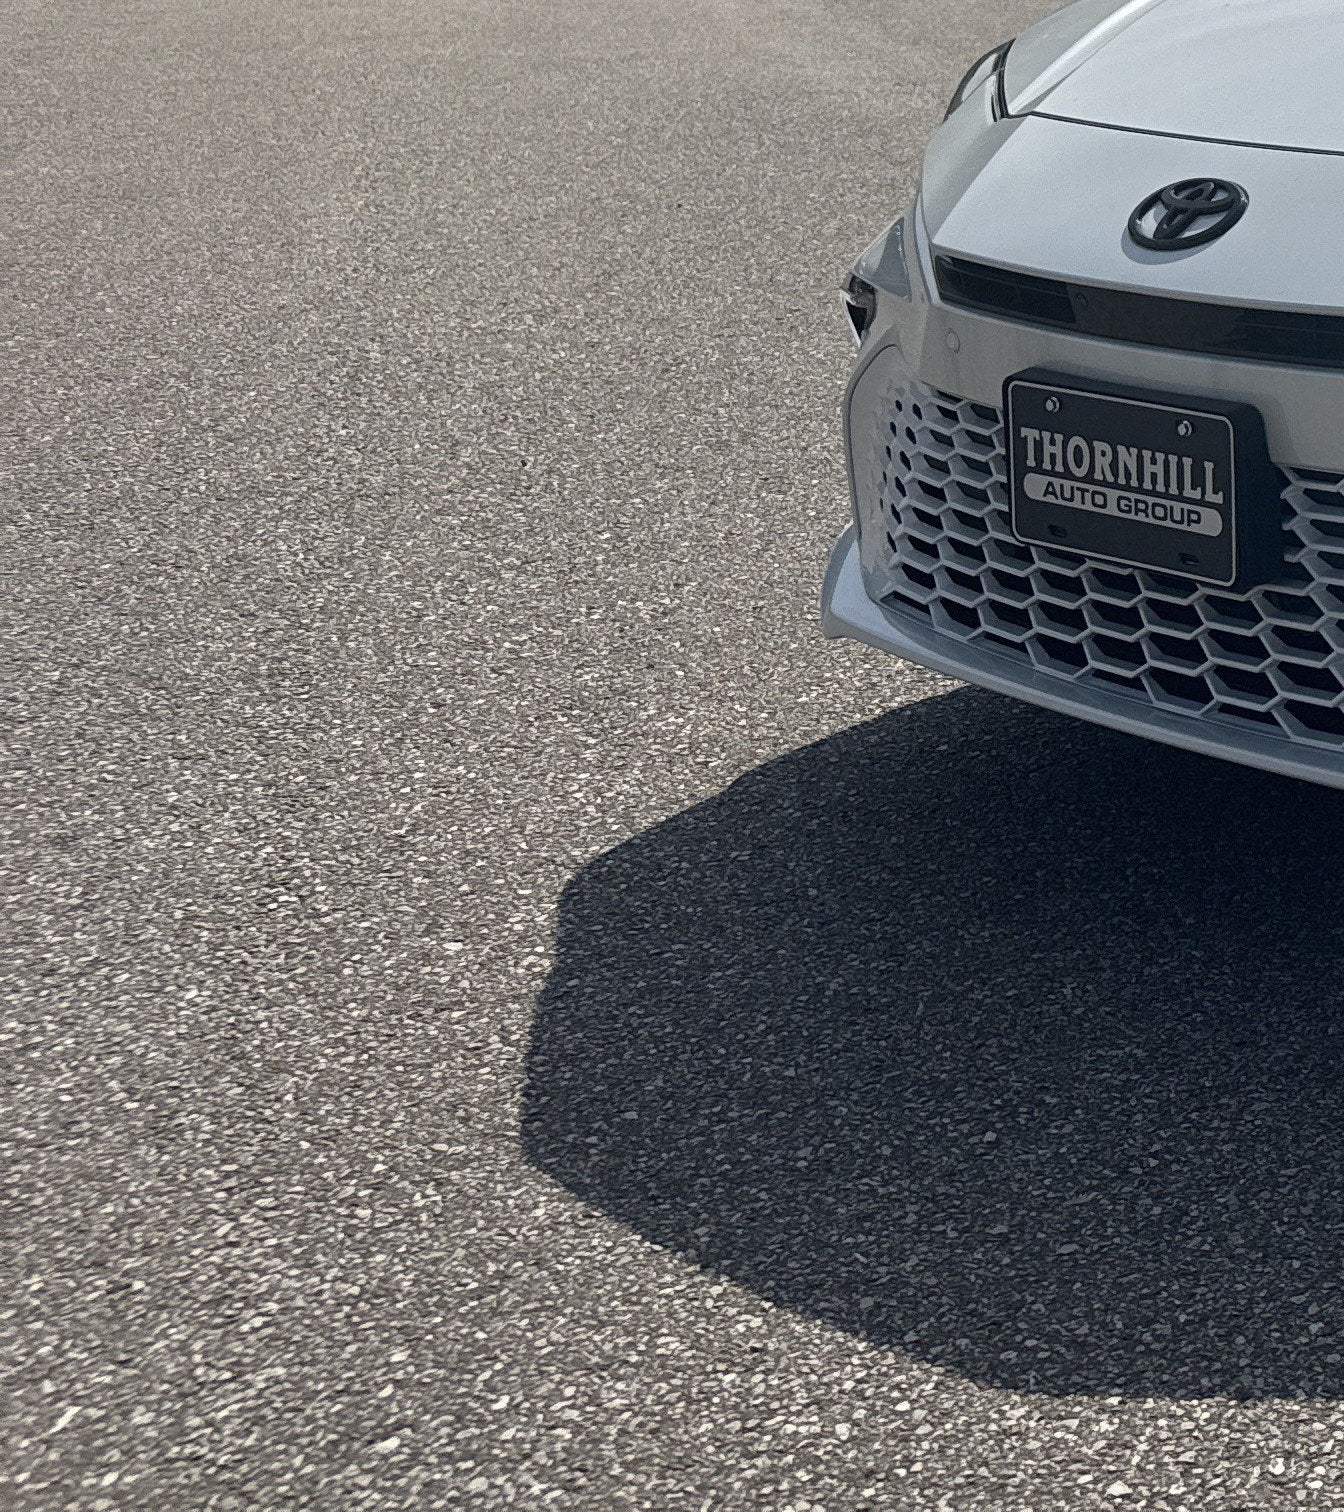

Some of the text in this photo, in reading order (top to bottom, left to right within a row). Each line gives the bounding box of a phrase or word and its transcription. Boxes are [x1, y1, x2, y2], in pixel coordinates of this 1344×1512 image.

[1020, 427, 1224, 504] THORNHILL
[1042, 480, 1203, 527] AUTO GROUP
